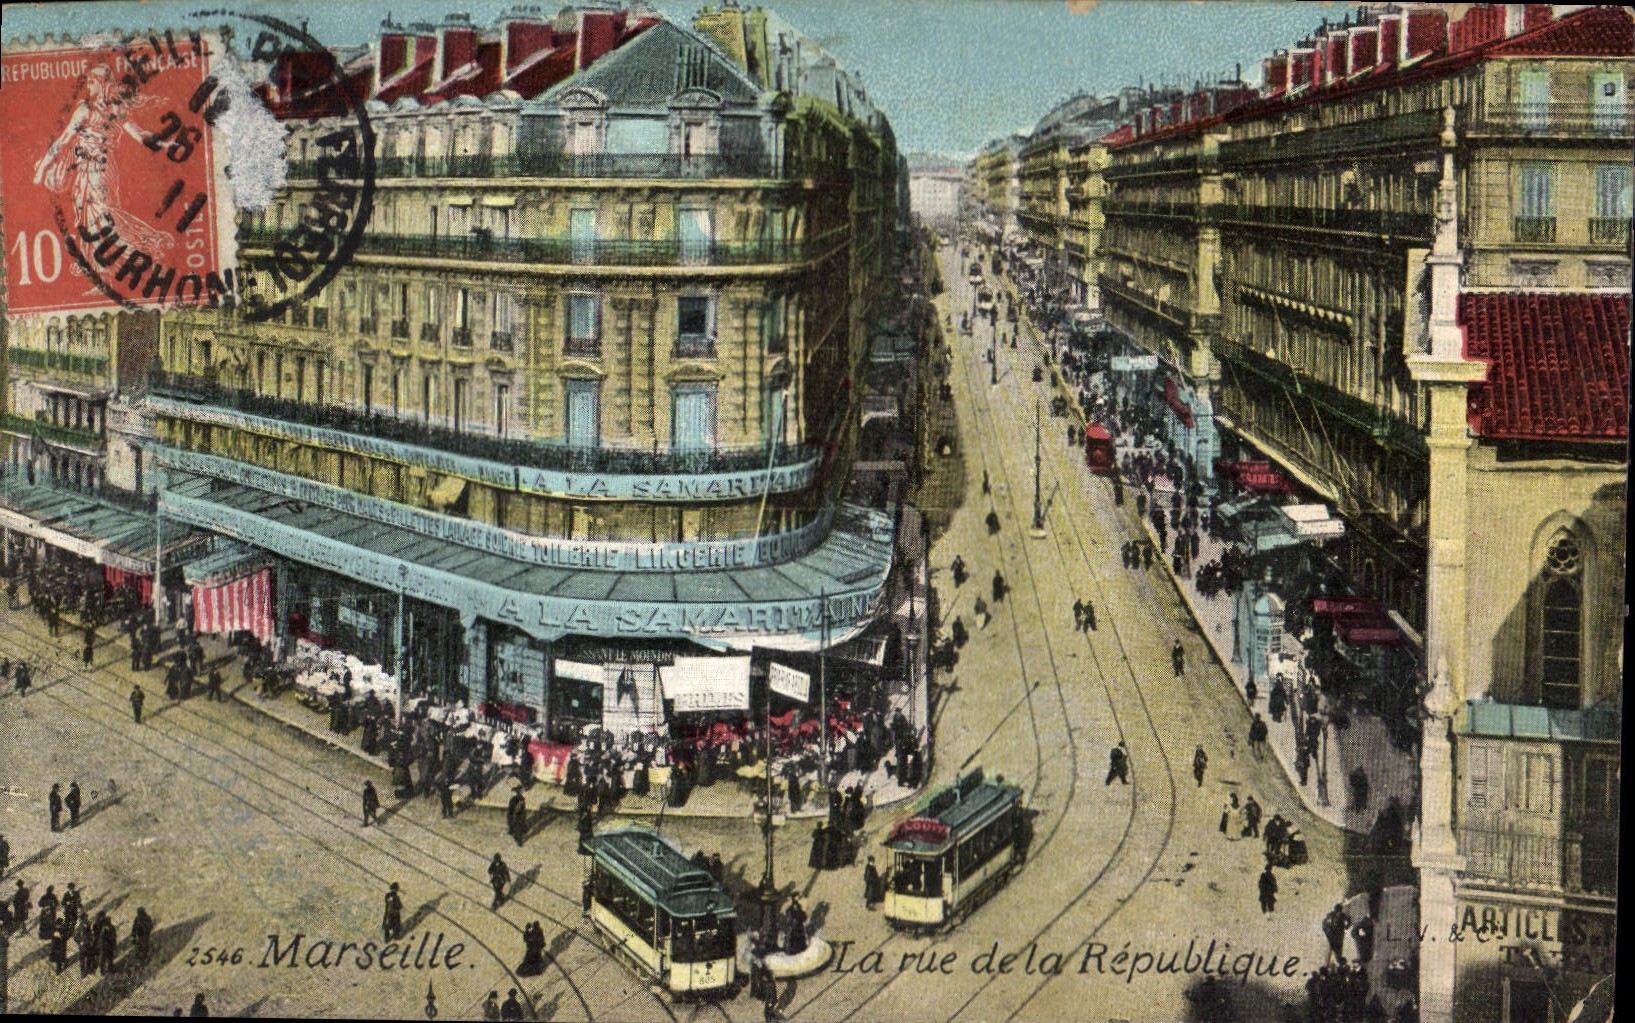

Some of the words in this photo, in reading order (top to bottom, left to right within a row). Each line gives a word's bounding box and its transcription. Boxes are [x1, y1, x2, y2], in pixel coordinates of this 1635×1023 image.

[11, 229, 62, 286] 10
[532, 472, 553, 493] A
[565, 476, 618, 498] LA
[636, 543, 745, 569] LINGERIE
[498, 597, 524, 622] A
[538, 600, 598, 631] LA
